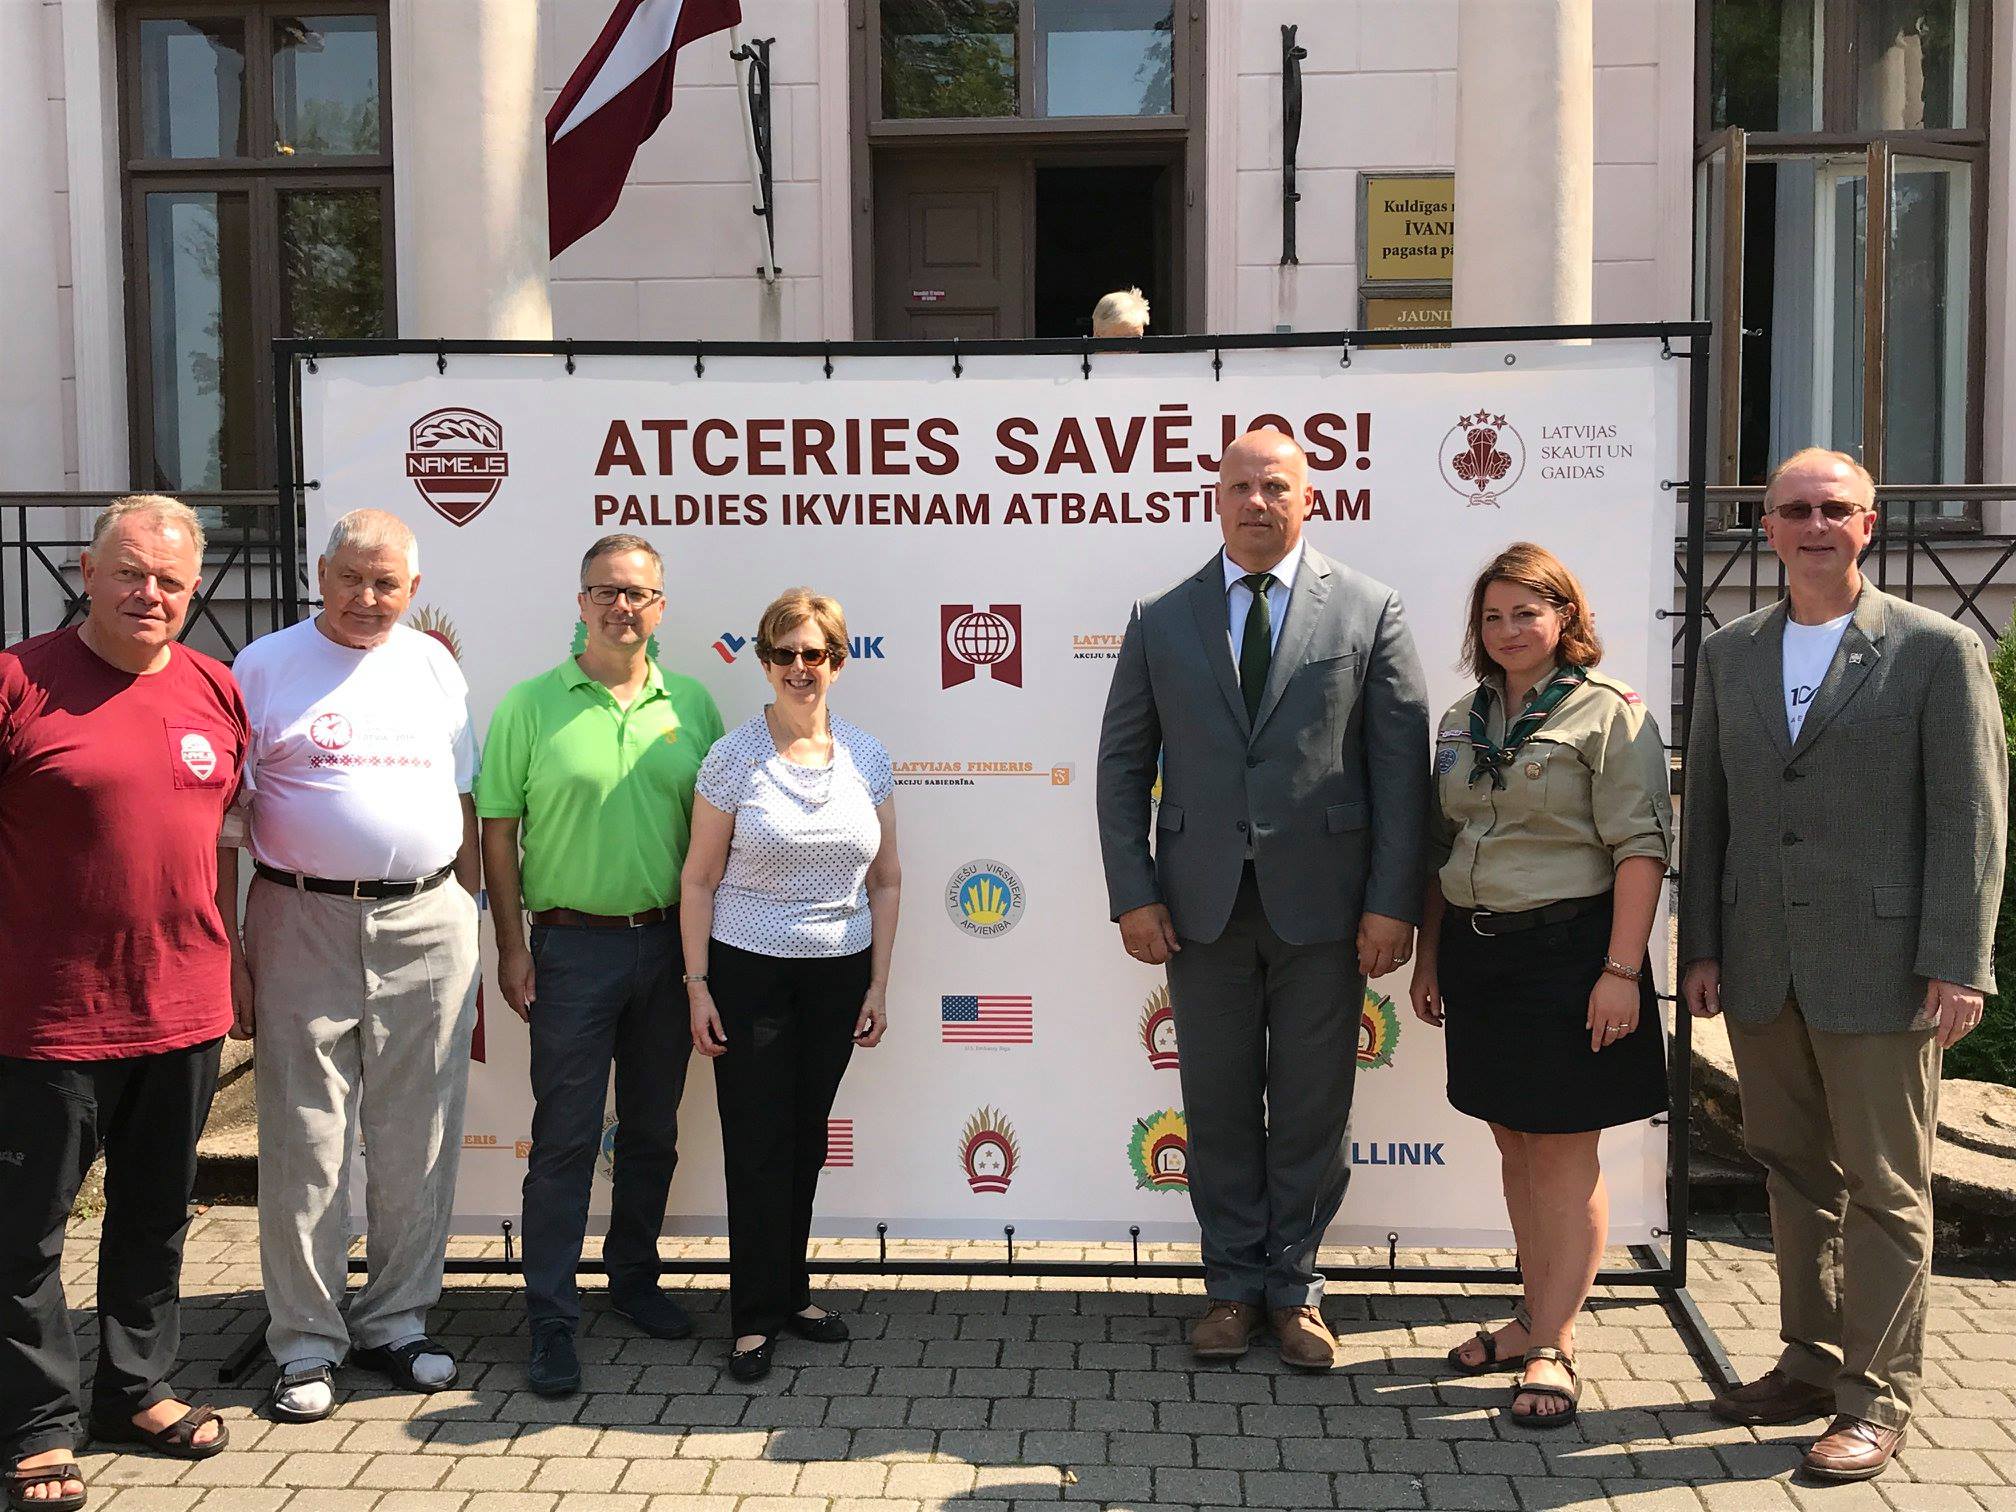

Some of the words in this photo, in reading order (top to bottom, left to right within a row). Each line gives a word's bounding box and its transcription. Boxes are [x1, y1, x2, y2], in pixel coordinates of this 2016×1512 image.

[1384, 200, 1447, 215] Kuldīgas
[1382, 245, 1437, 259] pagasta
[1398, 310, 1452, 321] JAUNI
[1542, 425, 1617, 440] LATVIJAS
[594, 418, 959, 476] ATCERIES
[1541, 446, 1602, 459] SKAUTI
[1607, 444, 1633, 458] UN
[409, 457, 505, 473] NAMEJS
[1541, 465, 1605, 479] GAIDAS
[594, 494, 768, 526] PALDIES
[782, 493, 990, 525] IKVIENAM
[1003, 484, 1371, 524] ATBALSTĪAM
[892, 762, 962, 772] LATVIJAS
[967, 762, 1033, 772] FINIERIS
[924, 778, 975, 786] SABIEDRĪBA
[949, 865, 977, 908] LATVIEŠU
[986, 863, 1021, 908] VIRSNIEKU
[960, 919, 1012, 935] APVIENĪBA
[464, 1135, 497, 1145] ERIS
[1352, 1142, 1446, 1165] LLINK
